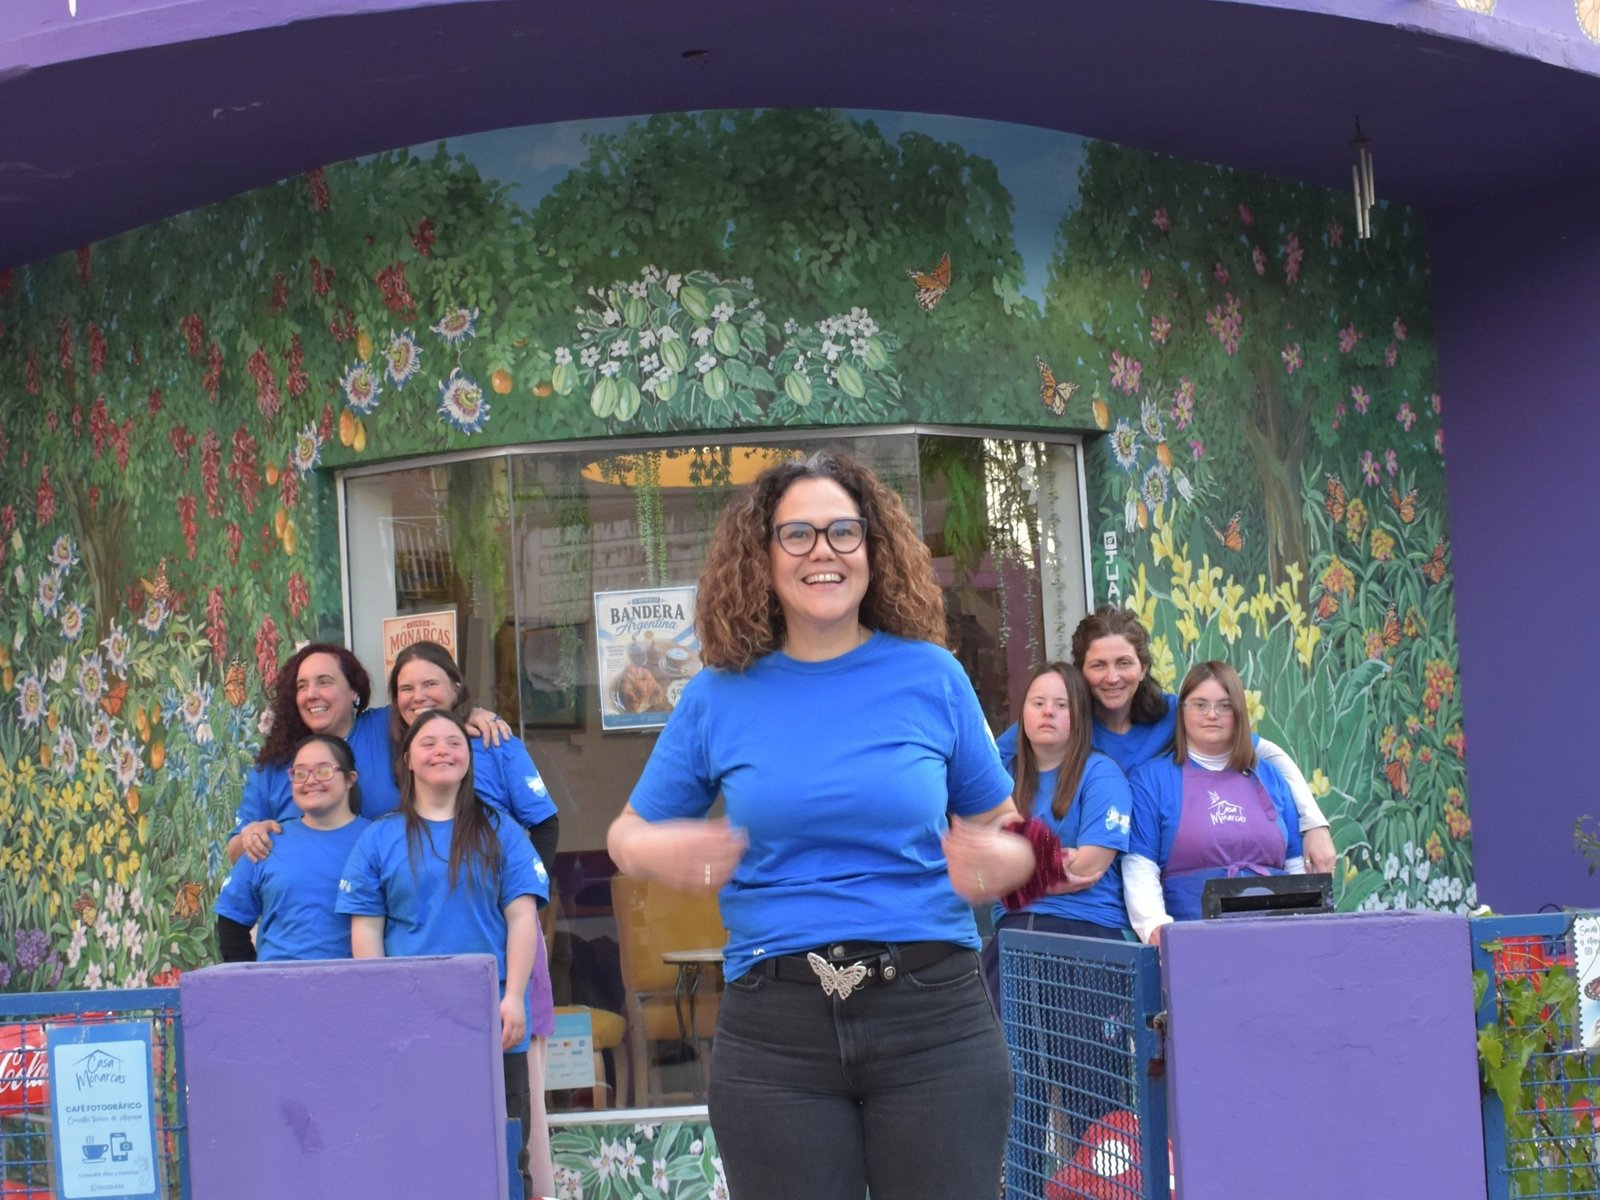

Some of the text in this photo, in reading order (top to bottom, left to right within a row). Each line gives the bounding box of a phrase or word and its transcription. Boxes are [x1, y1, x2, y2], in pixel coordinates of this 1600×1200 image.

[610, 604, 685, 625] BANDERA
[616, 617, 677, 637] Argentina
[390, 628, 451, 655] MONARCAS
[1217, 802, 1237, 816] Casa
[87, 1054, 114, 1074] Casa
[76, 1069, 126, 1092] Monarcas
[66, 1102, 142, 1113] CAFÉ FOTOGRÁFICO
